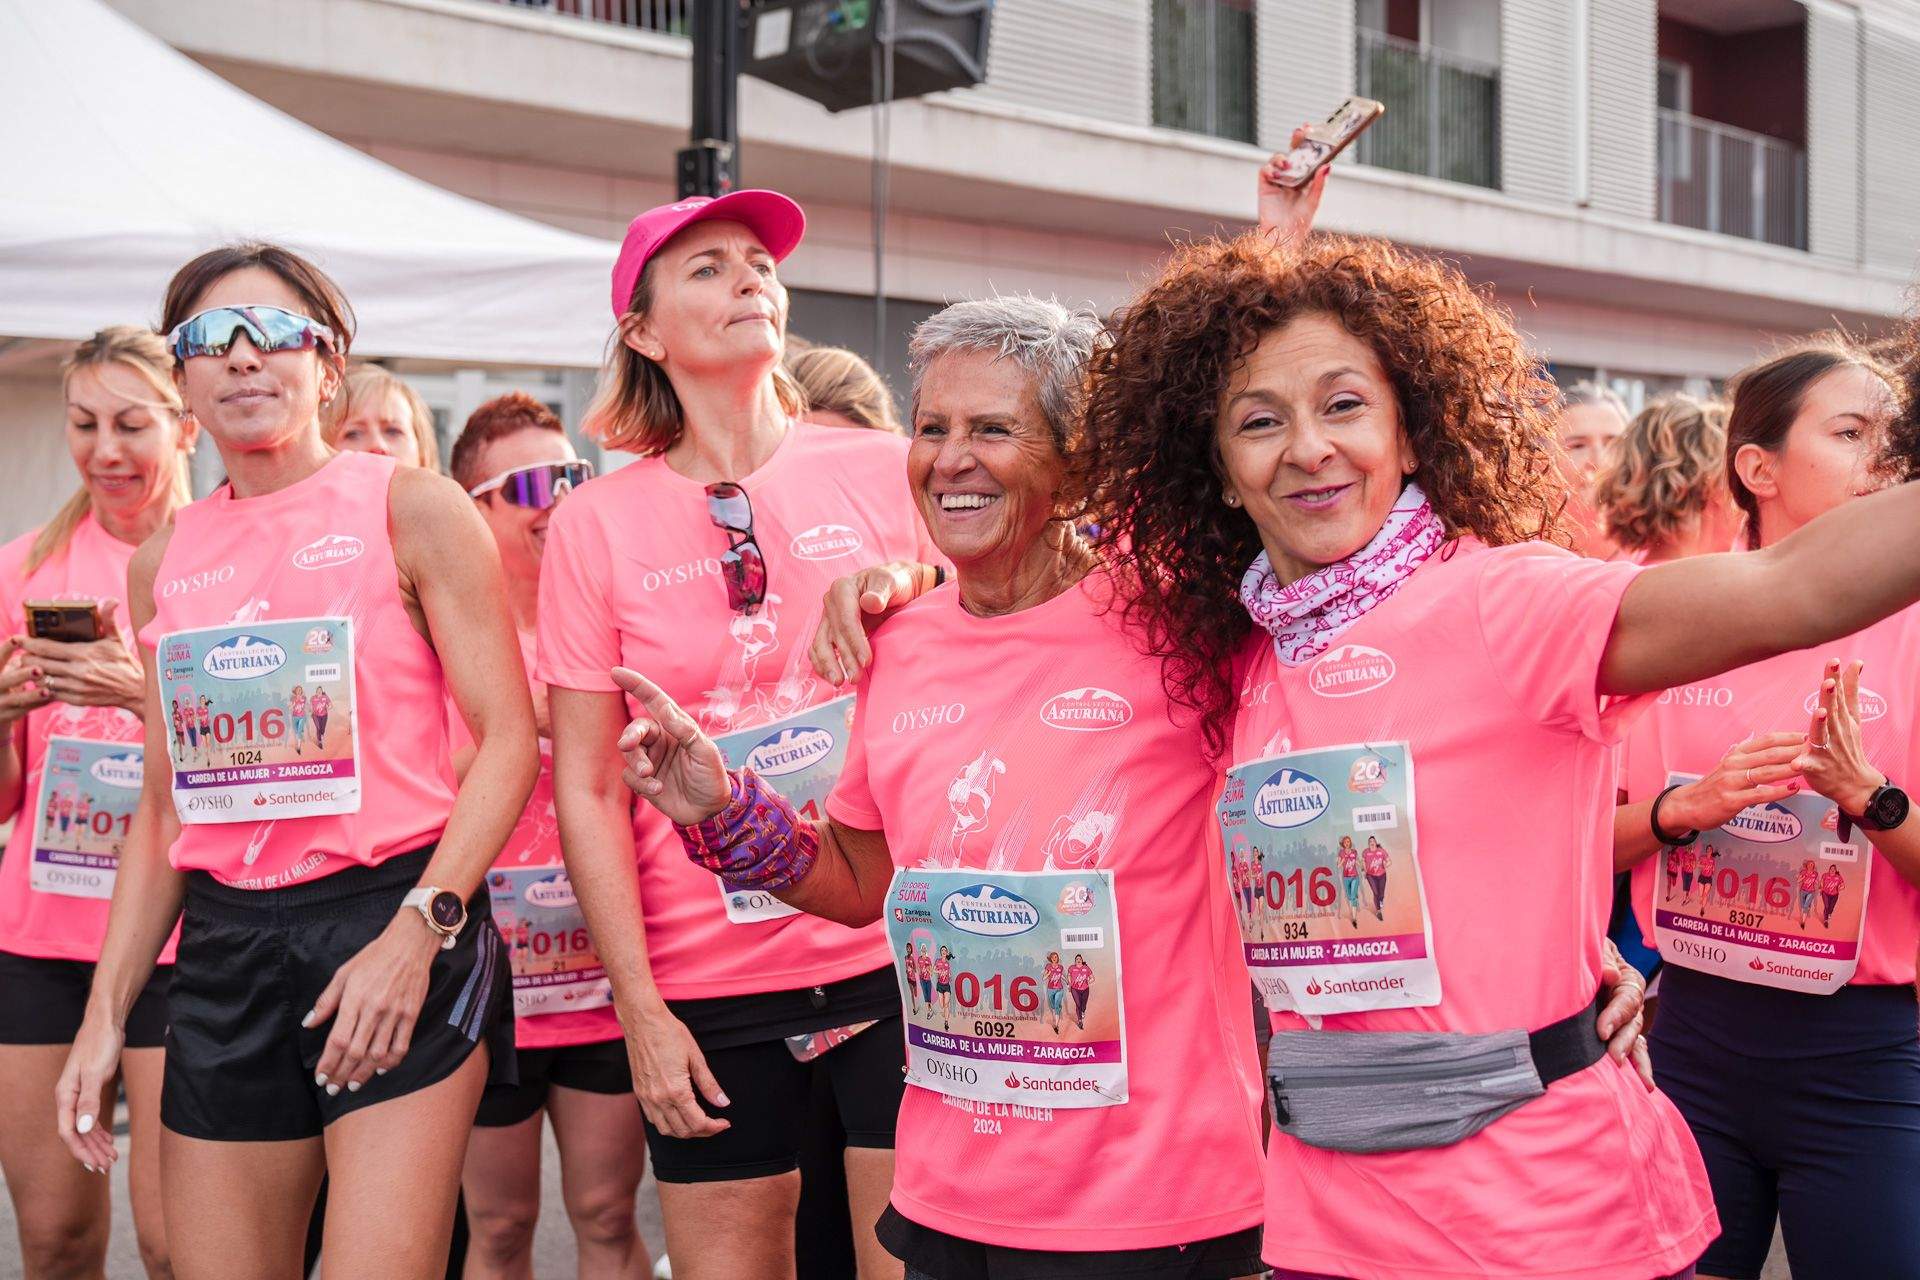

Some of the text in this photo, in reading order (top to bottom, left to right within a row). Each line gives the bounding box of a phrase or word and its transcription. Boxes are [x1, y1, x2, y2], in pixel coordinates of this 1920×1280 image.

[299, 546, 360, 564] ASTURIANA
[799, 537, 859, 555] ASTURIANA
[163, 565, 235, 598] OYSHO
[643, 558, 723, 592] OYSHO
[209, 654, 280, 672] ASTURIANA
[1315, 665, 1388, 690] ASTURIANA
[1656, 686, 1733, 707] OYSHO
[893, 702, 966, 736] OYSHO
[1046, 703, 1125, 722] ASTURIANA
[213, 709, 286, 744] 016
[230, 750, 263, 766] 1024
[754, 738, 830, 772] ASTURIANA
[96, 765, 141, 781] ASTURI
[187, 763, 334, 785] CARRERA DE LA MUJER ZARAGOZA
[188, 790, 336, 811] OYSHO Santander
[1258, 794, 1324, 816] ASTURIANA
[92, 811, 132, 836] 01
[1727, 816, 1795, 836] STURIANA
[265, 874, 278, 889] DE
[280, 869, 292, 885] LA
[291, 852, 327, 879] MUJER
[897, 890, 928, 903] SUMA
[1265, 867, 1337, 911] 016
[1716, 868, 1791, 908] 016
[904, 908, 931, 917] Zaragoza
[948, 901, 1033, 925] ASTURIANA
[1729, 910, 1764, 928] 8307
[533, 928, 590, 955] 016
[1284, 921, 1309, 940] 934
[1673, 916, 1836, 955] CARRERA DE LA MUJER ZARAGOZA
[1271, 948, 1279, 960] DE
[1279, 947, 1288, 960] LA
[1290, 945, 1324, 960] MUJER
[1332, 940, 1399, 958] ZARAGOZA
[1673, 938, 1834, 982] OYSHO Santander
[953, 971, 1040, 1013] 016
[1324, 977, 1405, 995] Santander
[974, 1020, 1016, 1038] 6092
[922, 1032, 1096, 1060] CARRERA DE LA MUJER ZARAGOZA
[926, 1058, 1098, 1092] OYSHO Santander
[976, 1100, 992, 1116] DE
[994, 1103, 1010, 1118] LA
[1012, 1104, 1053, 1122] MUJER
[973, 1118, 1003, 1135] 2024
